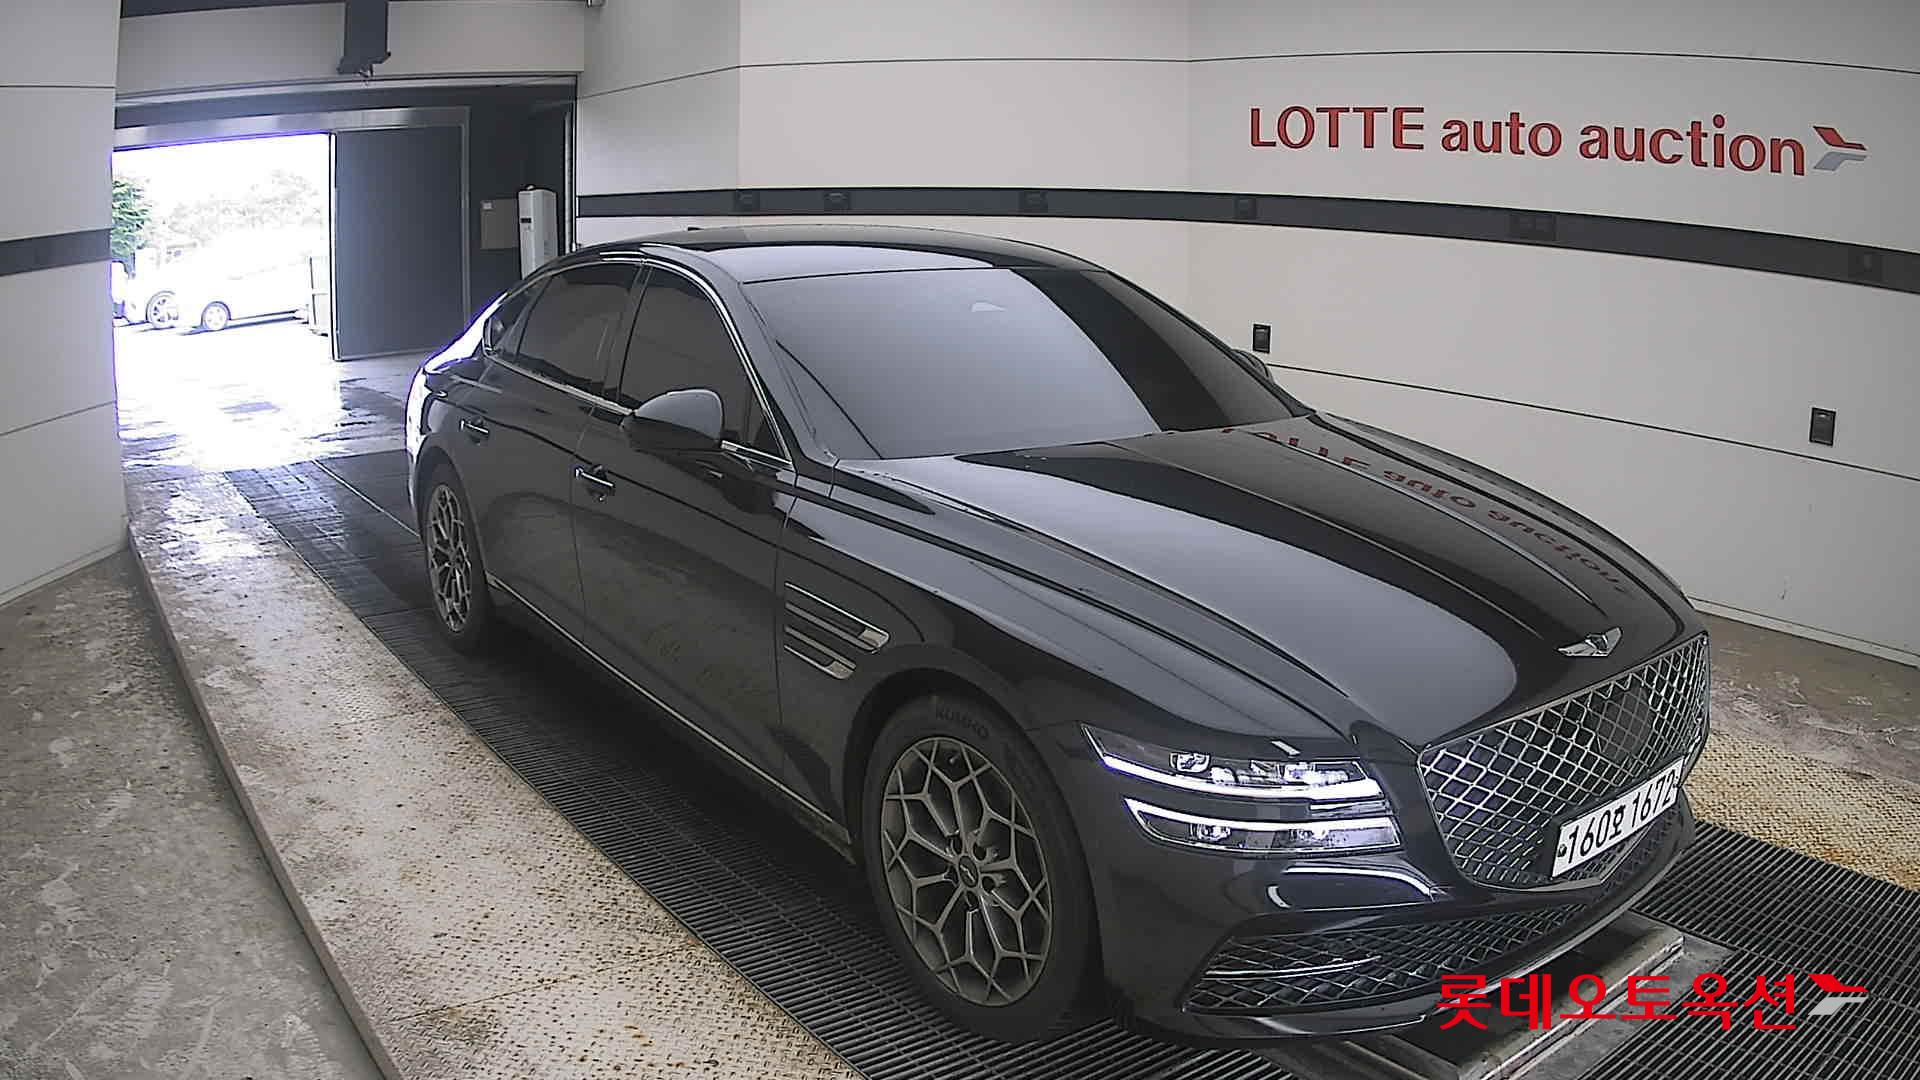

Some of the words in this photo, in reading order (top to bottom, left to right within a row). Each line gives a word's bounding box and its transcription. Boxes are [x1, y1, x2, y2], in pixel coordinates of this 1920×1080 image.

[1250, 106, 1425, 150] LOTTE
[1441, 111, 1563, 156] auto
[1578, 114, 1806, 176] auction
[1568, 804, 1626, 864] 160호
[1632, 769, 1676, 828] 1672
